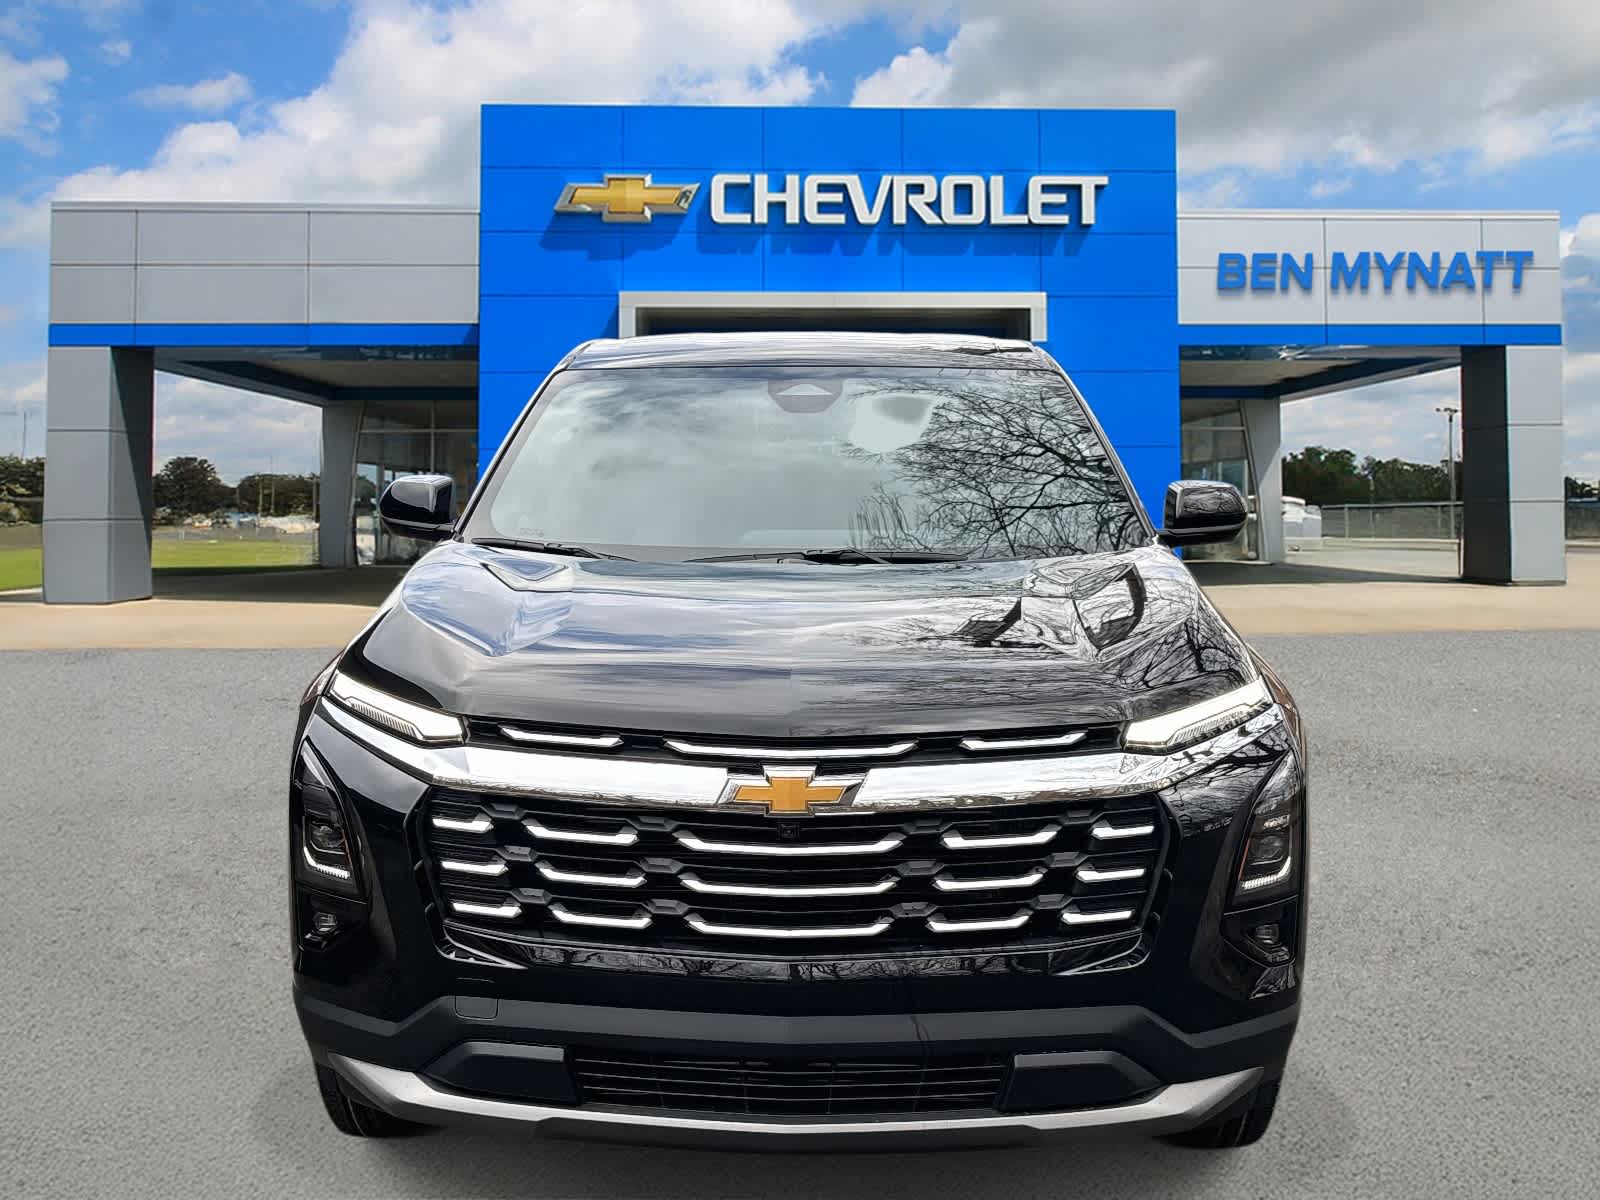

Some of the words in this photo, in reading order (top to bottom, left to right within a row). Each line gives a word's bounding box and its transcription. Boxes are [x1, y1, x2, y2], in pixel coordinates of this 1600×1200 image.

[710, 174, 1109, 226] CHEVROLET
[1217, 252, 1313, 290] BEN
[1330, 250, 1534, 290] MYNATT
